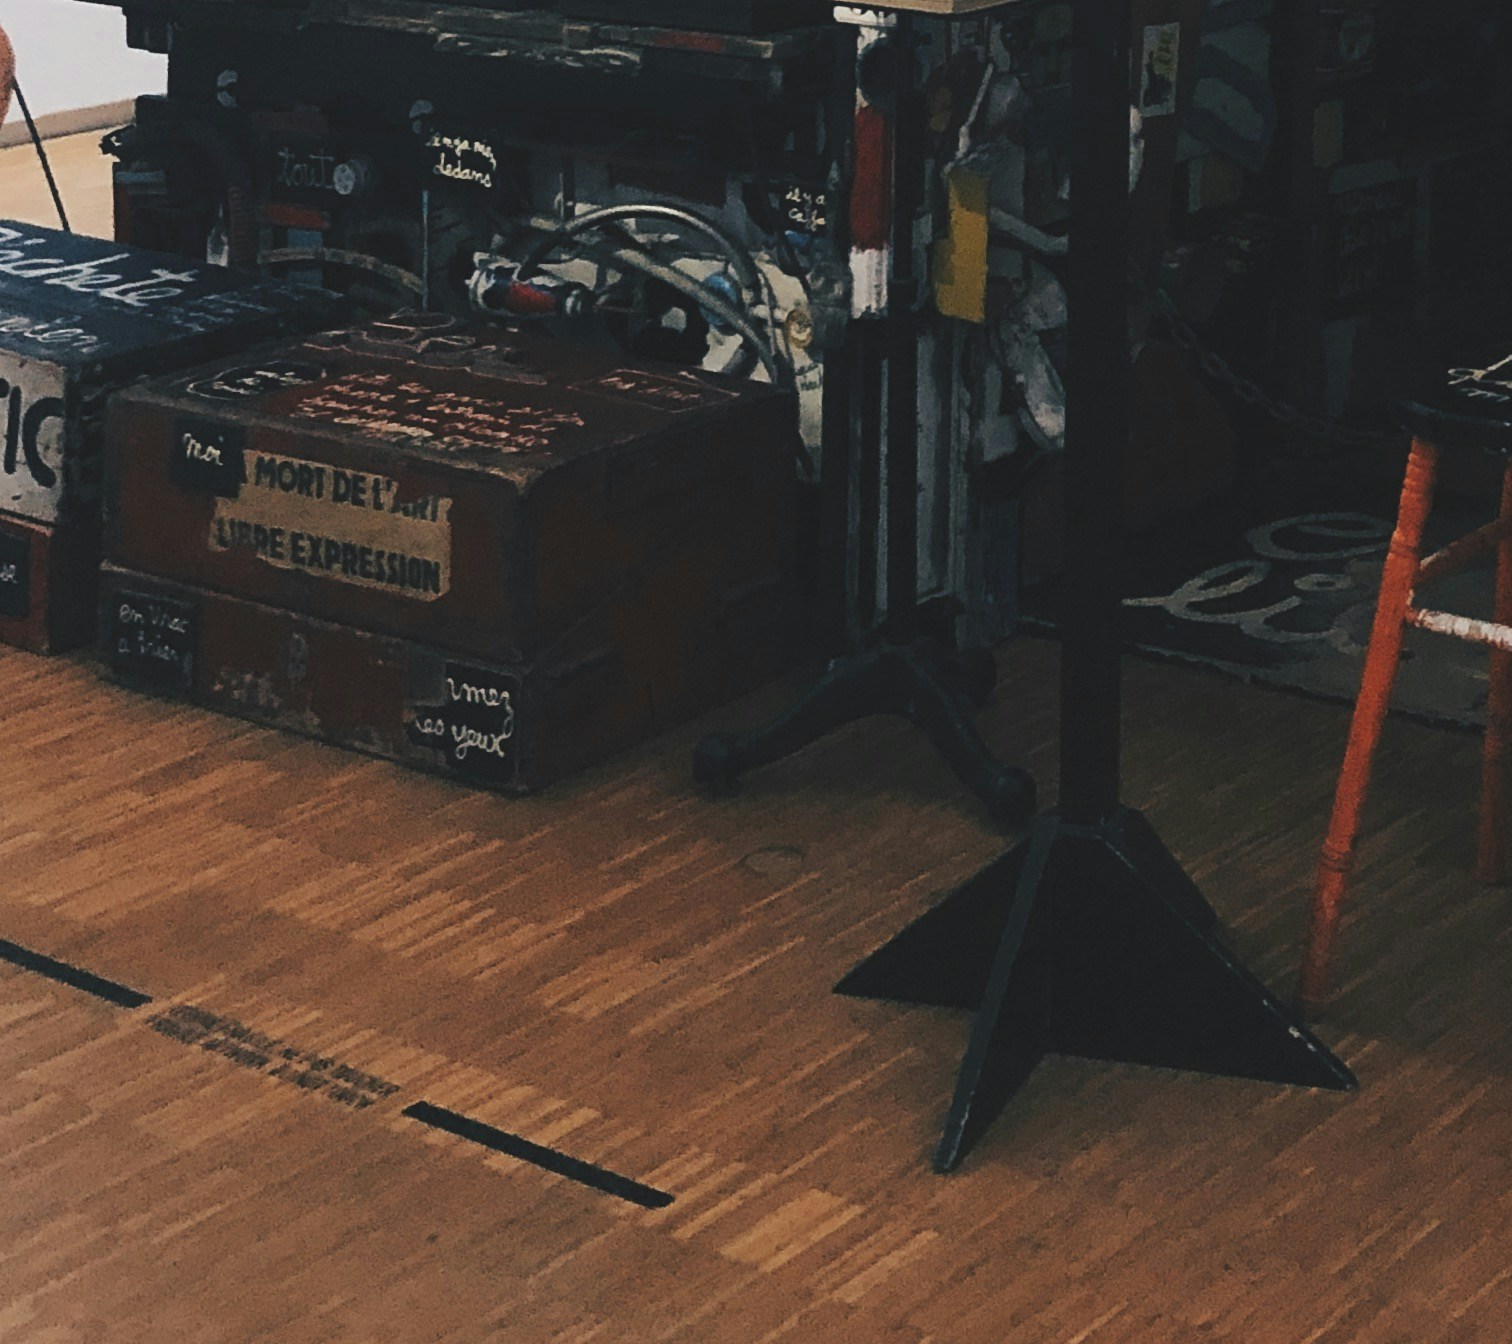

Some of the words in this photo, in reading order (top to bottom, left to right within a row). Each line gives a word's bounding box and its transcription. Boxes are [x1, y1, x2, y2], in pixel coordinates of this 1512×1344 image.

[253, 455, 326, 500] MORT
[332, 470, 366, 509] DE
[290, 530, 443, 596] EXPRESSION
